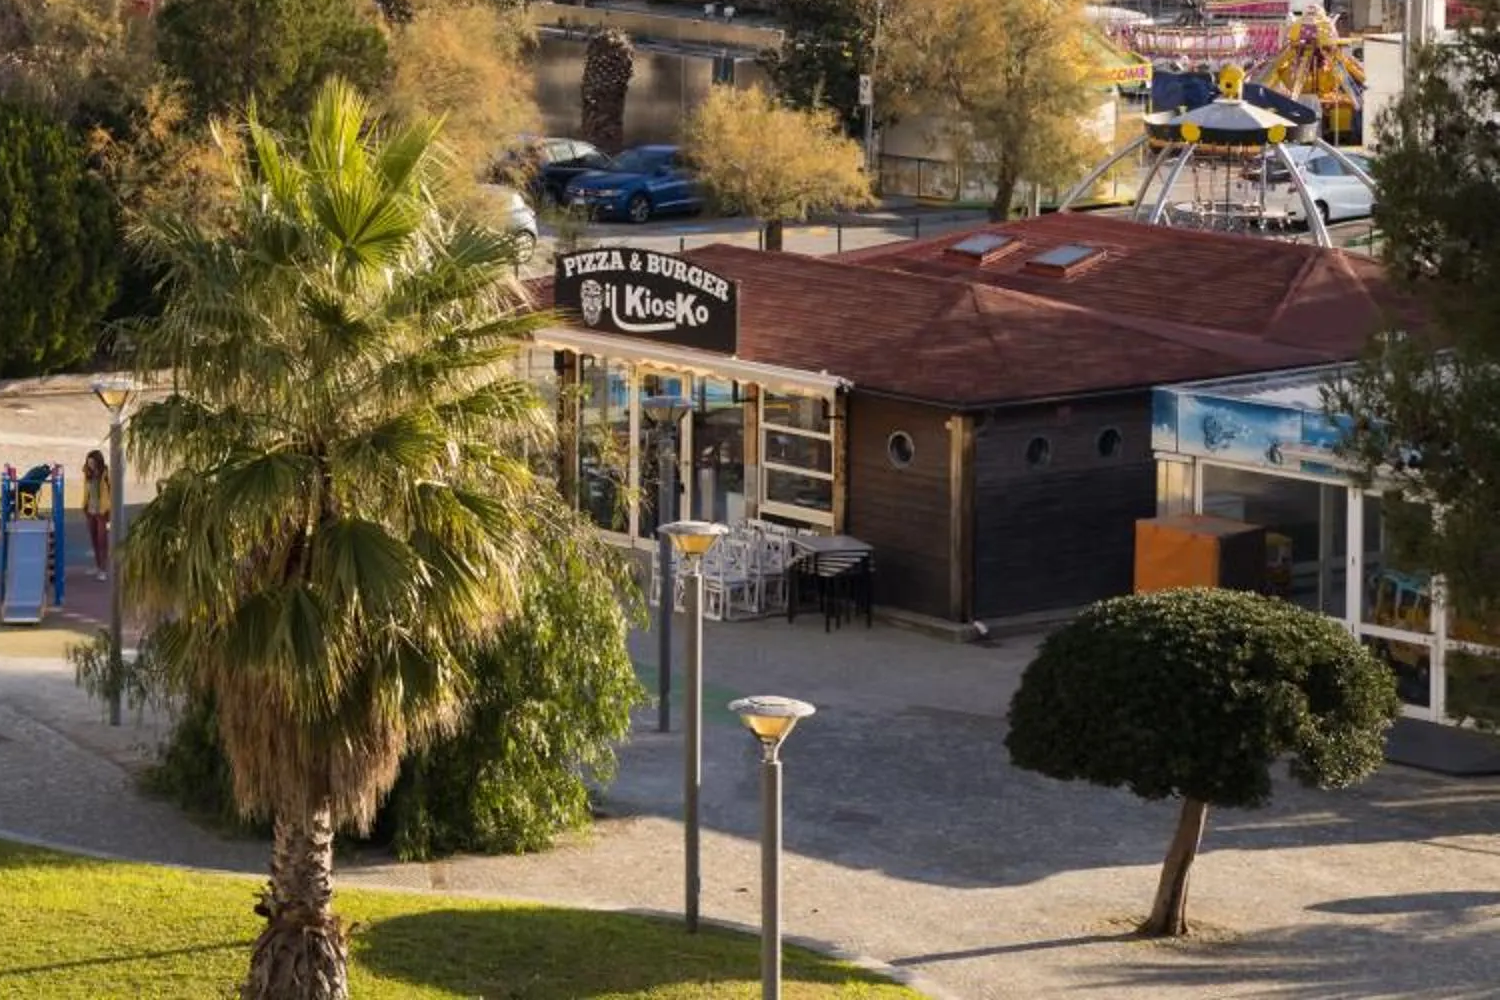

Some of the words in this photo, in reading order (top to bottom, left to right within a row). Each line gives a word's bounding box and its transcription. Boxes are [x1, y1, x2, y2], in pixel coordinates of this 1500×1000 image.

[564, 250, 624, 277] PIZZA
[629, 252, 642, 272] &
[647, 253, 729, 301] BURGER
[625, 284, 709, 327] KiosKo
